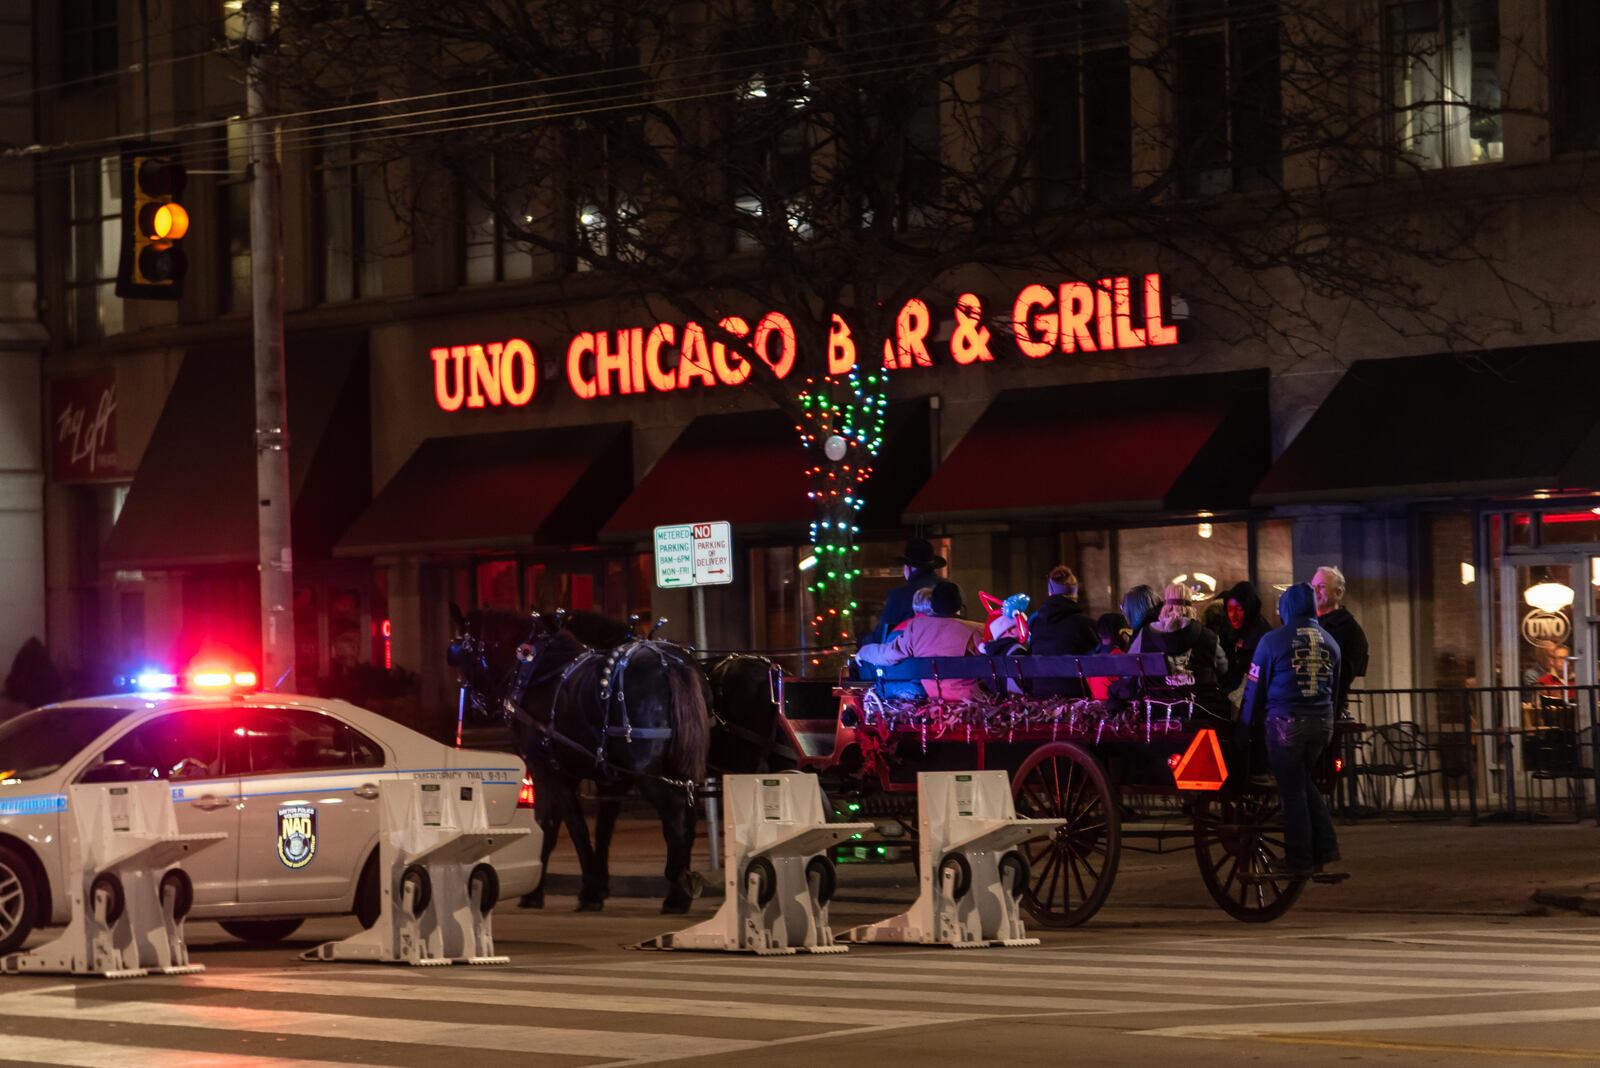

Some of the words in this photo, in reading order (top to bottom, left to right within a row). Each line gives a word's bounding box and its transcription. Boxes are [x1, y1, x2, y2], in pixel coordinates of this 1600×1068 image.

[430, 338, 537, 411] UNO
[566, 311, 796, 399] CHICAGO
[828, 298, 934, 375] BR
[951, 292, 994, 365] &
[1012, 273, 1178, 358] GRILL
[658, 530, 689, 540] METERED
[694, 526, 710, 538] NO
[660, 543, 689, 552] PARKING
[698, 541, 726, 549] PARKING
[660, 555, 690, 564] 8AM-6PM
[697, 557, 727, 566] DELIVERY
[662, 567, 689, 575] MON-FRI
[1527, 618, 1565, 637] UNO
